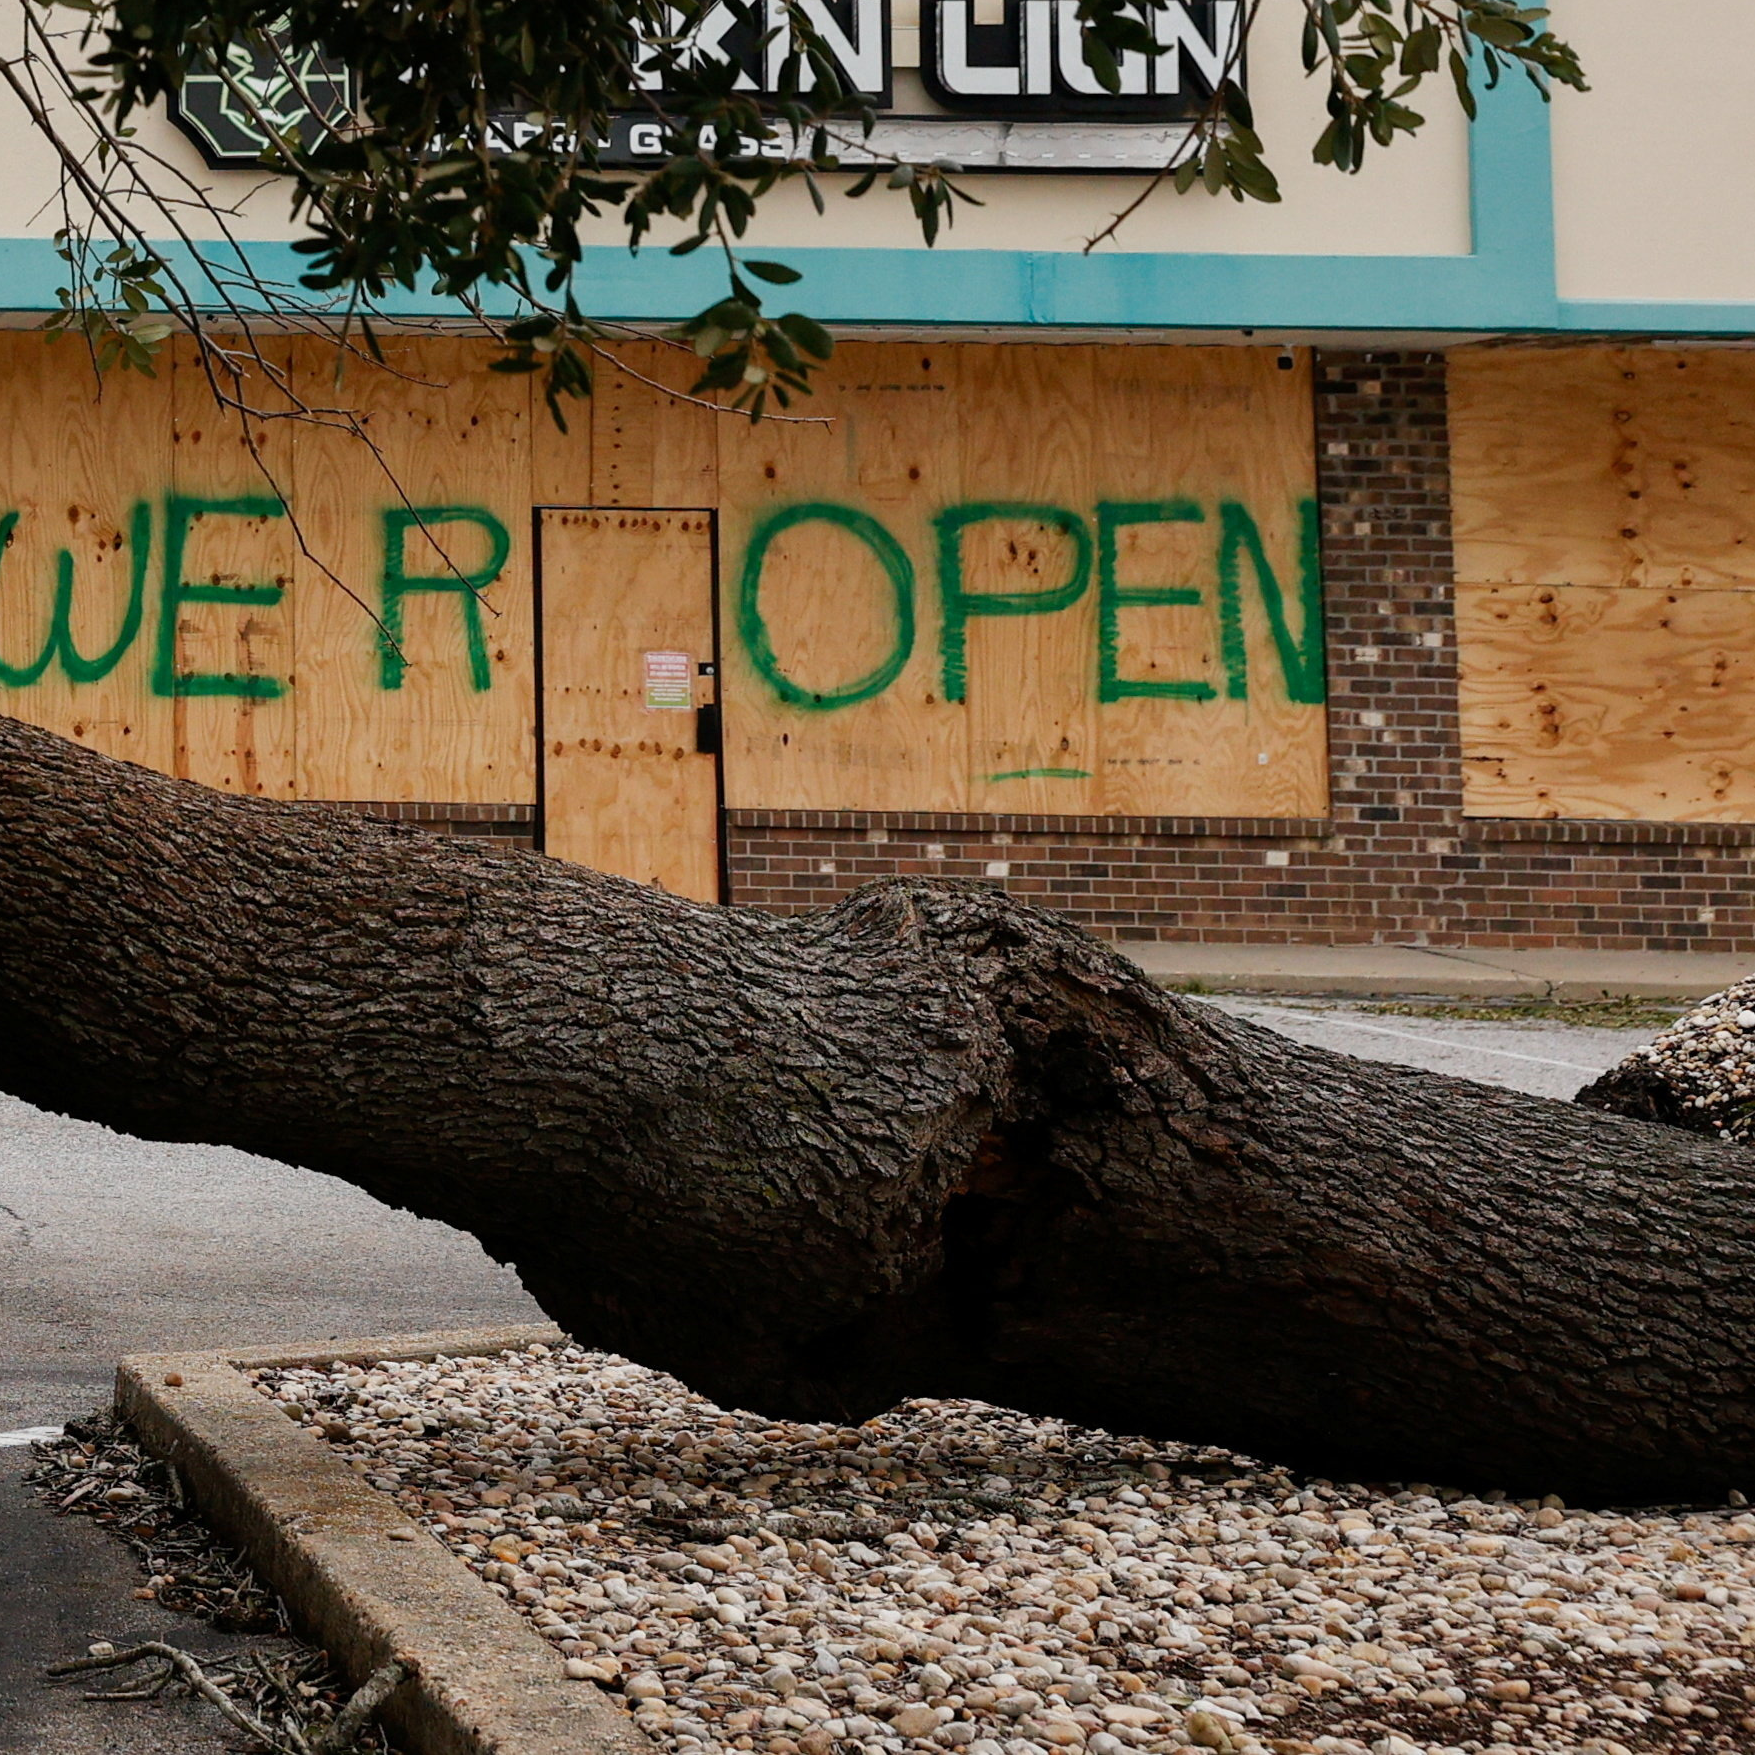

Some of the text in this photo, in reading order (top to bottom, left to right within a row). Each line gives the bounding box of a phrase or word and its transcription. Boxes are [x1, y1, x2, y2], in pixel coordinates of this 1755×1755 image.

[936, 0, 1241, 95] LION
[630, 123, 785, 155] GASS
[377, 505, 511, 692] R
[738, 497, 1328, 712] OPEN
